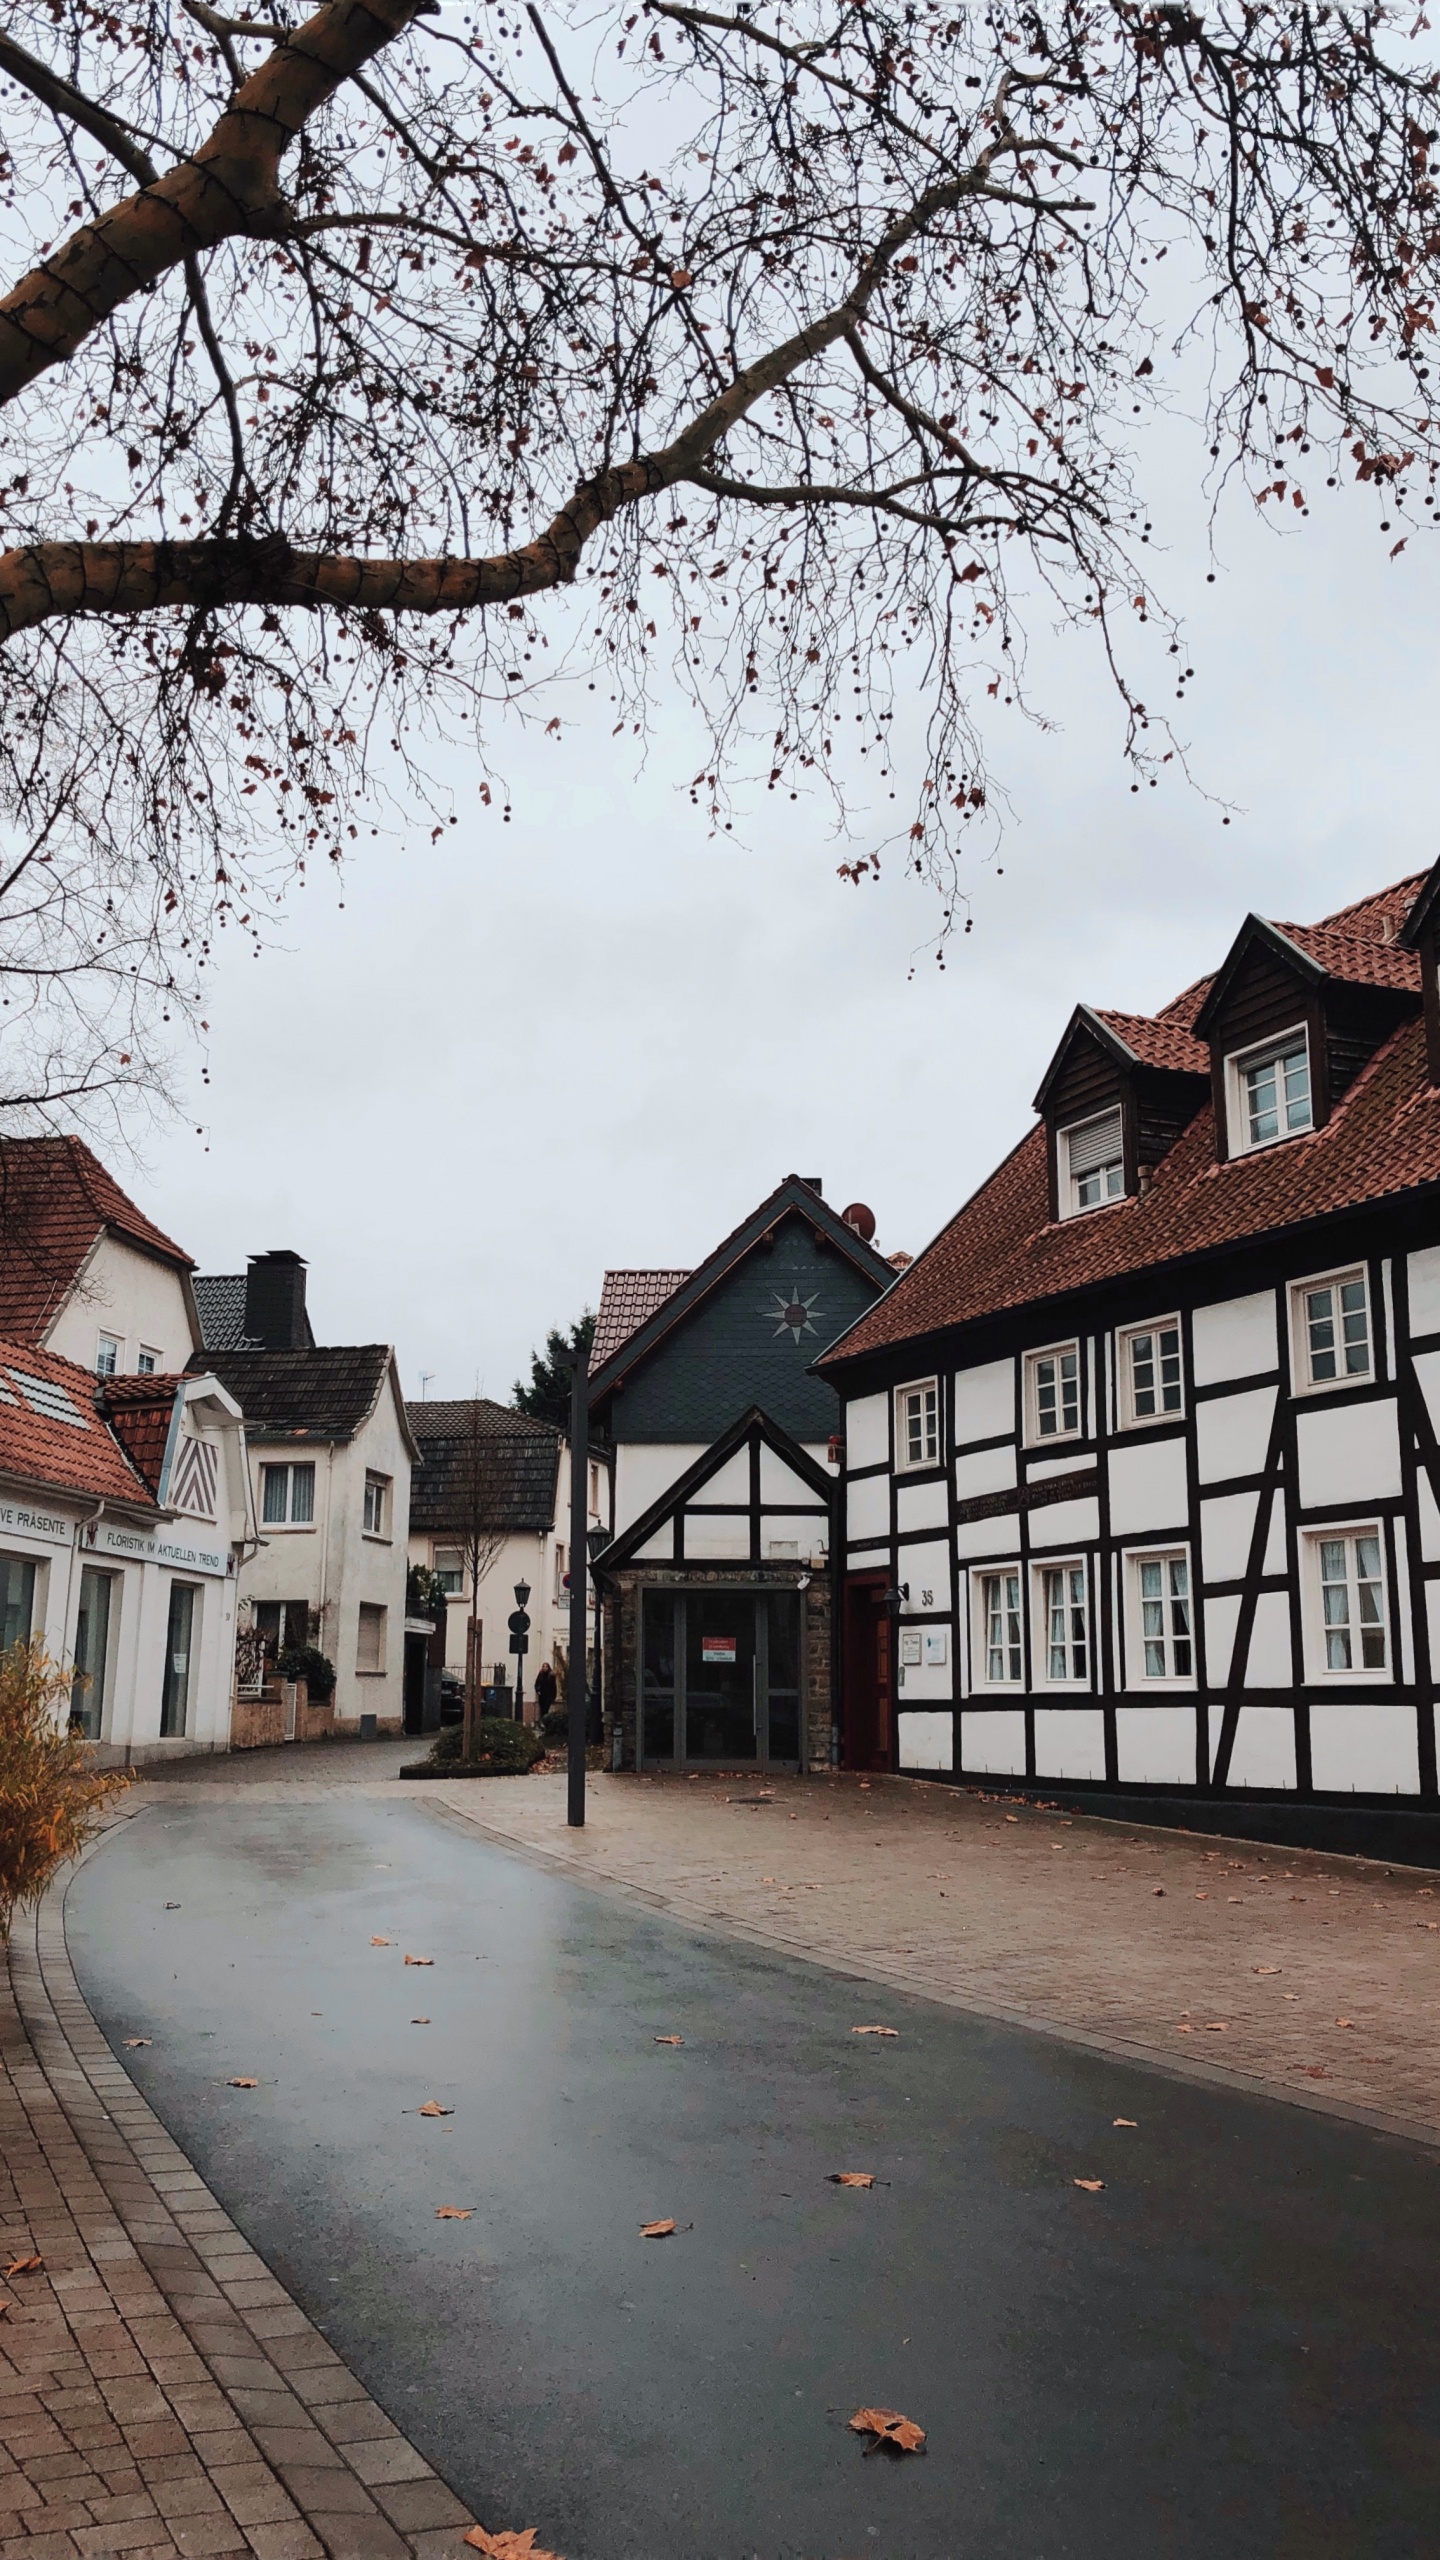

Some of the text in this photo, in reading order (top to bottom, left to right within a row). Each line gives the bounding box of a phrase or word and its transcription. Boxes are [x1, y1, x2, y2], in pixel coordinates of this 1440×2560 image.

[17, 1511, 66, 1535] PRÄSENTE
[107, 1532, 220, 1567] FLORISTIK IM AKTUELLEN TREND
